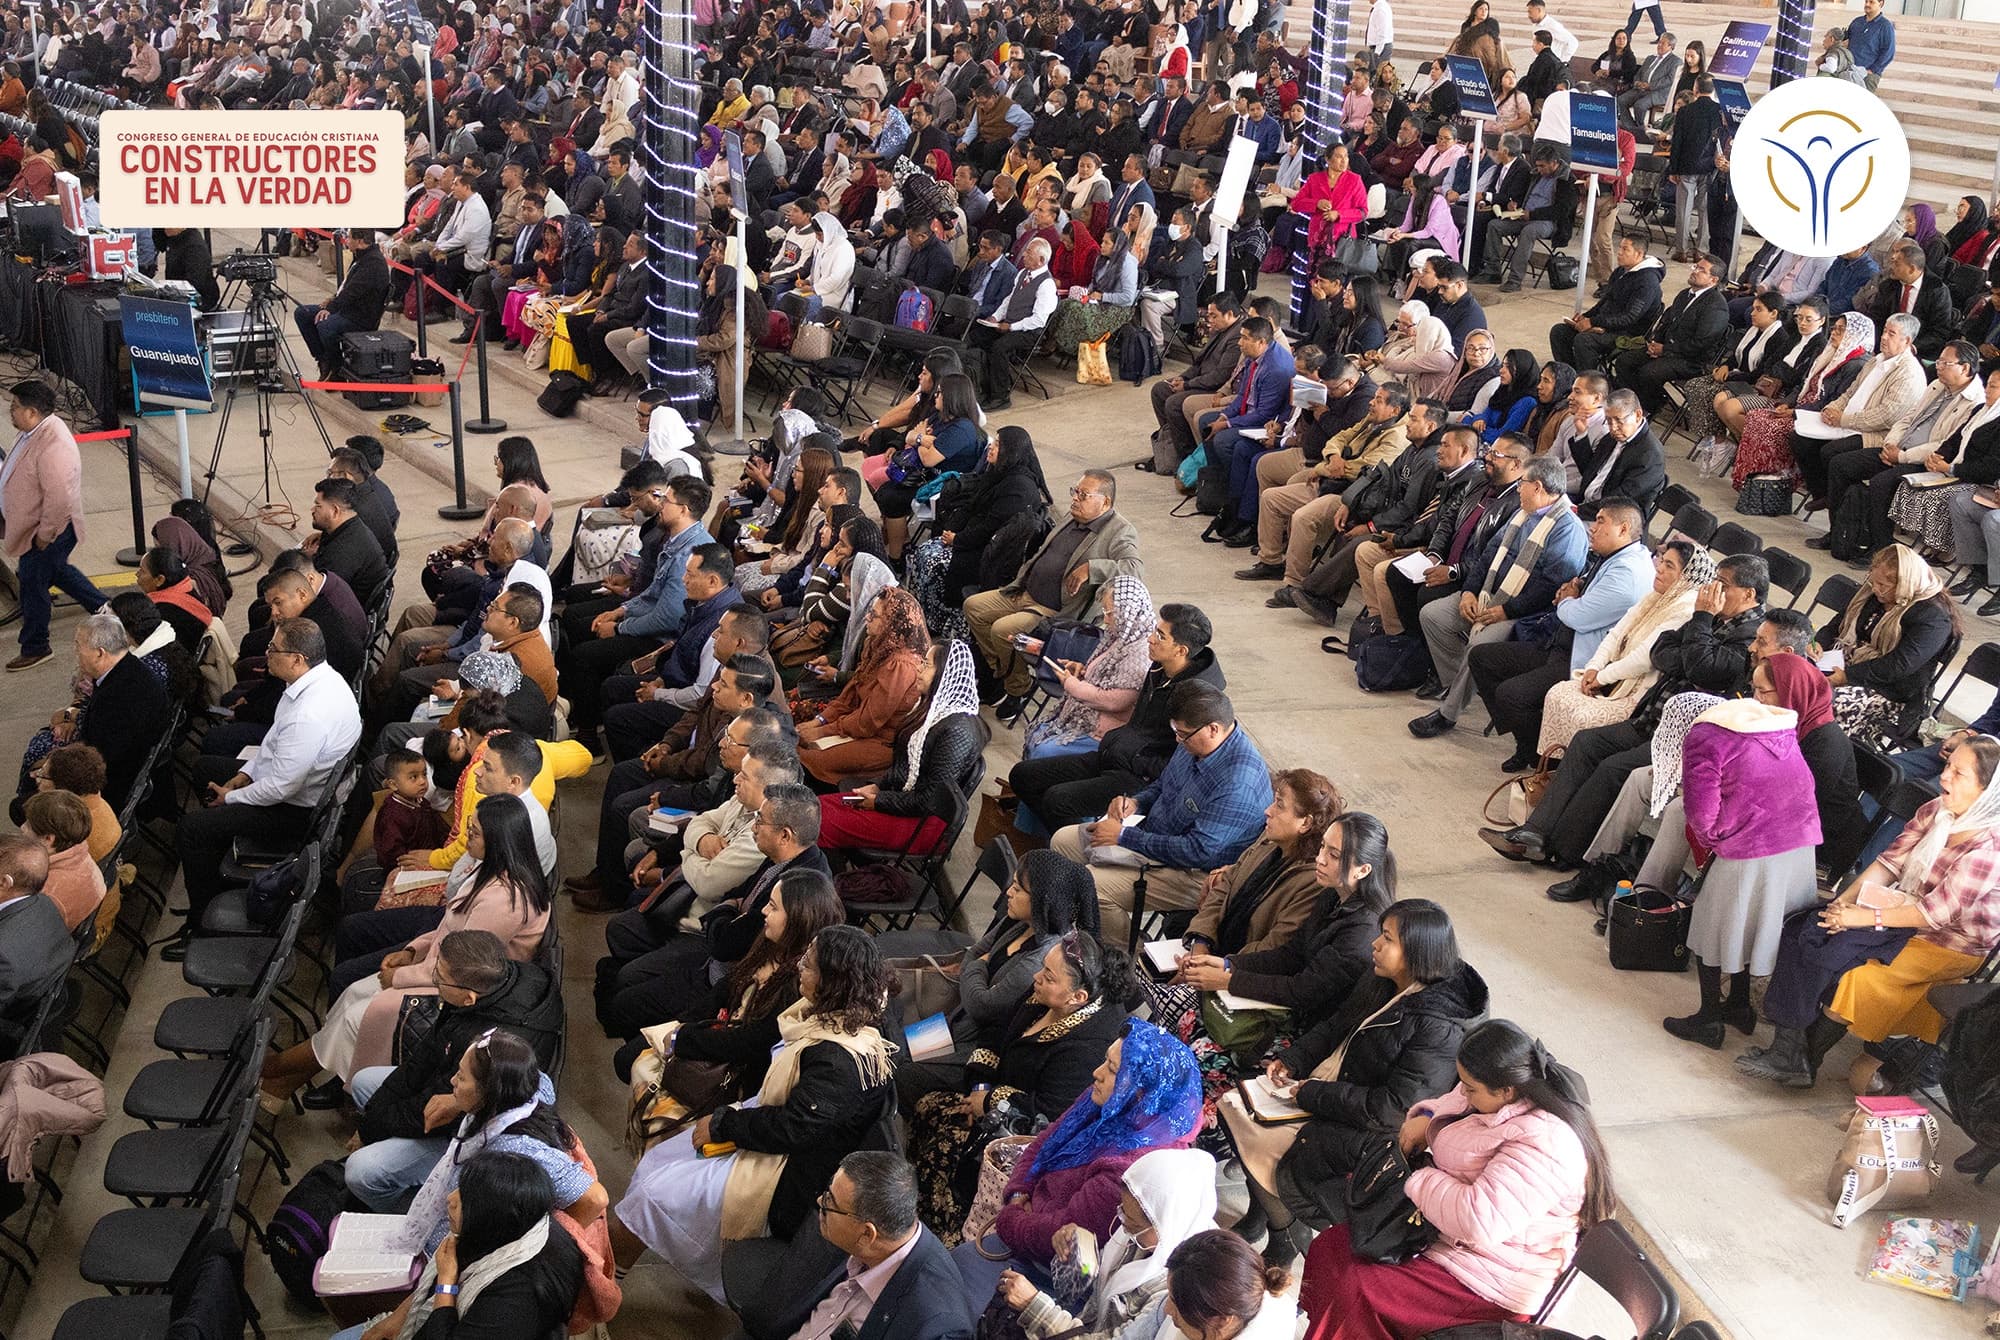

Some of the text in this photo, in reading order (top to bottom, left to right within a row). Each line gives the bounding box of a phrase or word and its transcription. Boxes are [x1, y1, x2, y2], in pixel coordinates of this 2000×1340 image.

[1723, 37, 1762, 48] California
[1724, 48, 1749, 58] E.U.A.
[1572, 126, 1616, 142] Tamaulipas
[135, 311, 179, 326] presbiterio
[130, 345, 199, 366] Guanajuato
